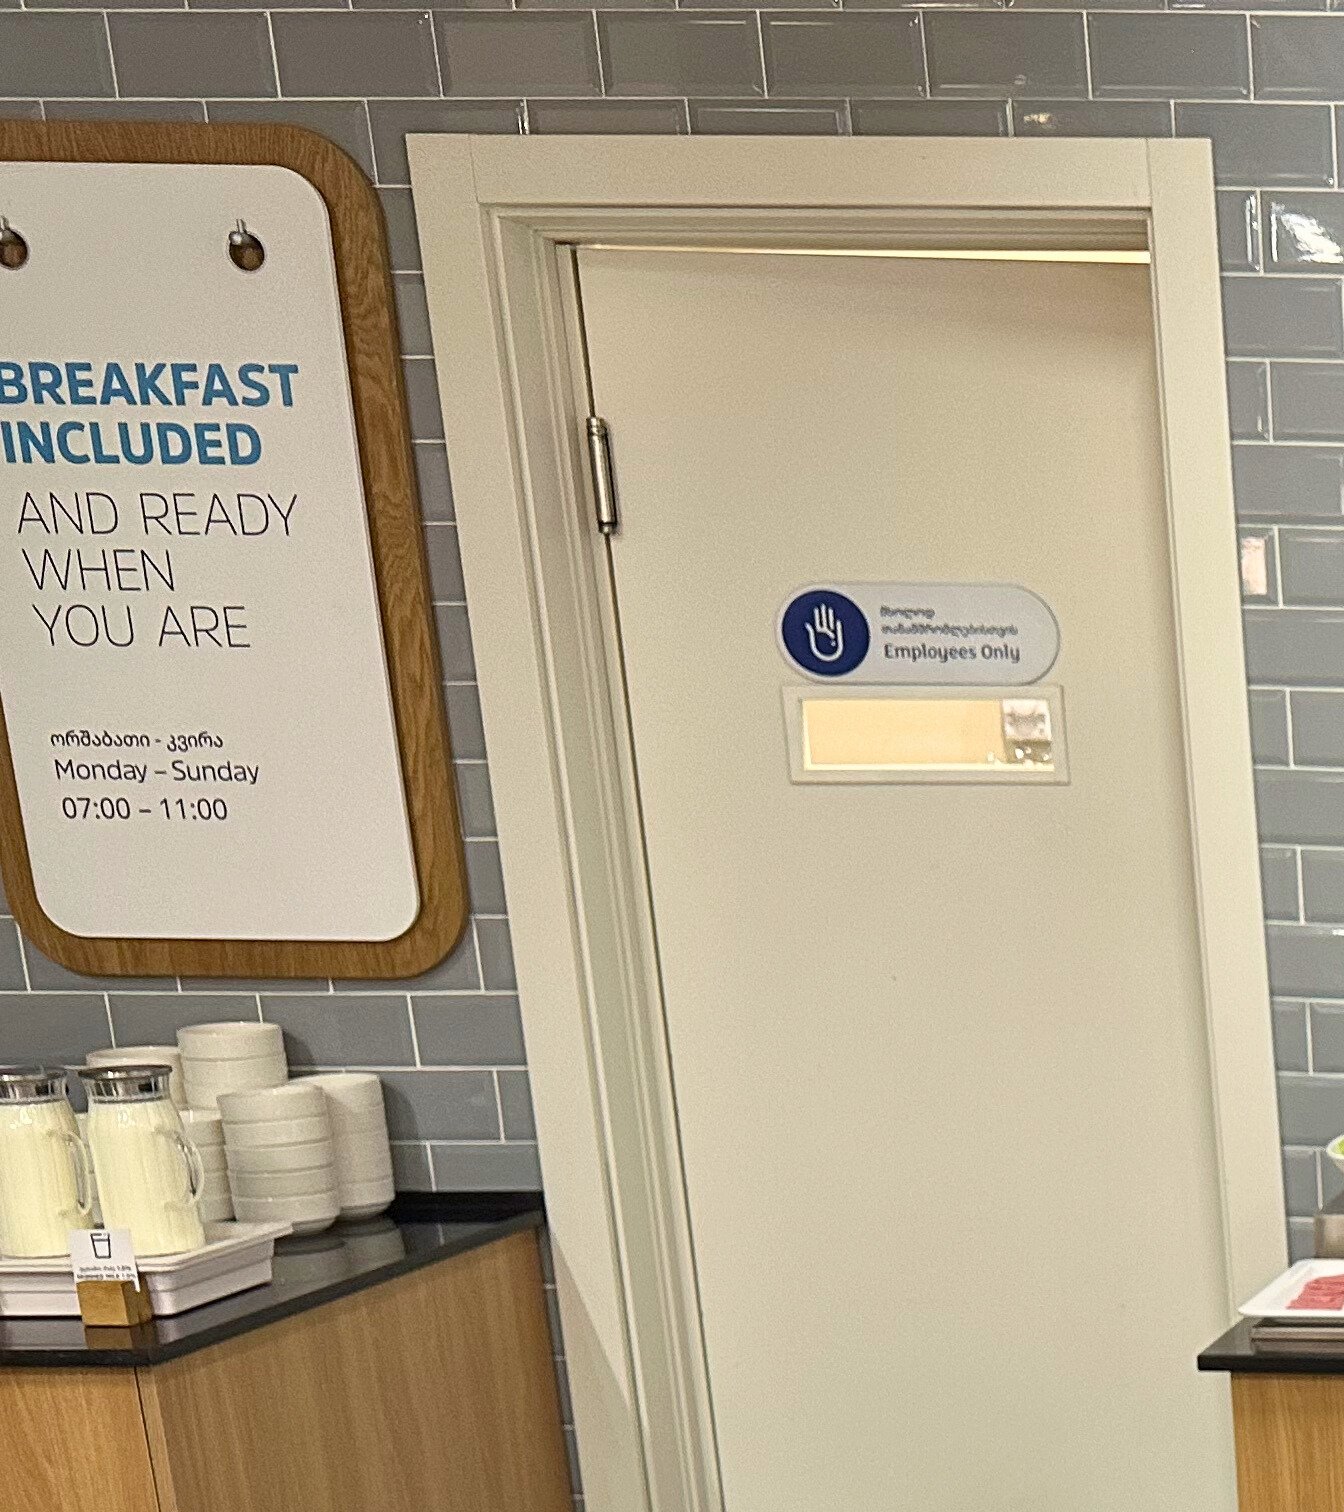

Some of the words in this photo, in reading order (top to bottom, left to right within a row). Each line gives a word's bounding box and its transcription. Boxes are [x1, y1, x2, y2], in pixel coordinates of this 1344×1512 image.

[0, 361, 299, 407] BREAKFAST
[0, 421, 262, 465] INCLUDED
[18, 491, 119, 535] AND
[140, 492, 298, 536] READY
[22, 548, 175, 591] WHEN
[32, 604, 135, 648] YOU
[159, 605, 251, 648] ARE
[884, 643, 977, 662] Employees
[981, 642, 1020, 663] Only
[50, 730, 150, 747] ორშაბათი
[166, 731, 224, 752] კვირა
[54, 759, 148, 783] Monday
[171, 760, 259, 785] Sunday
[62, 797, 131, 820] 07:00
[159, 797, 228, 820] 11:00
